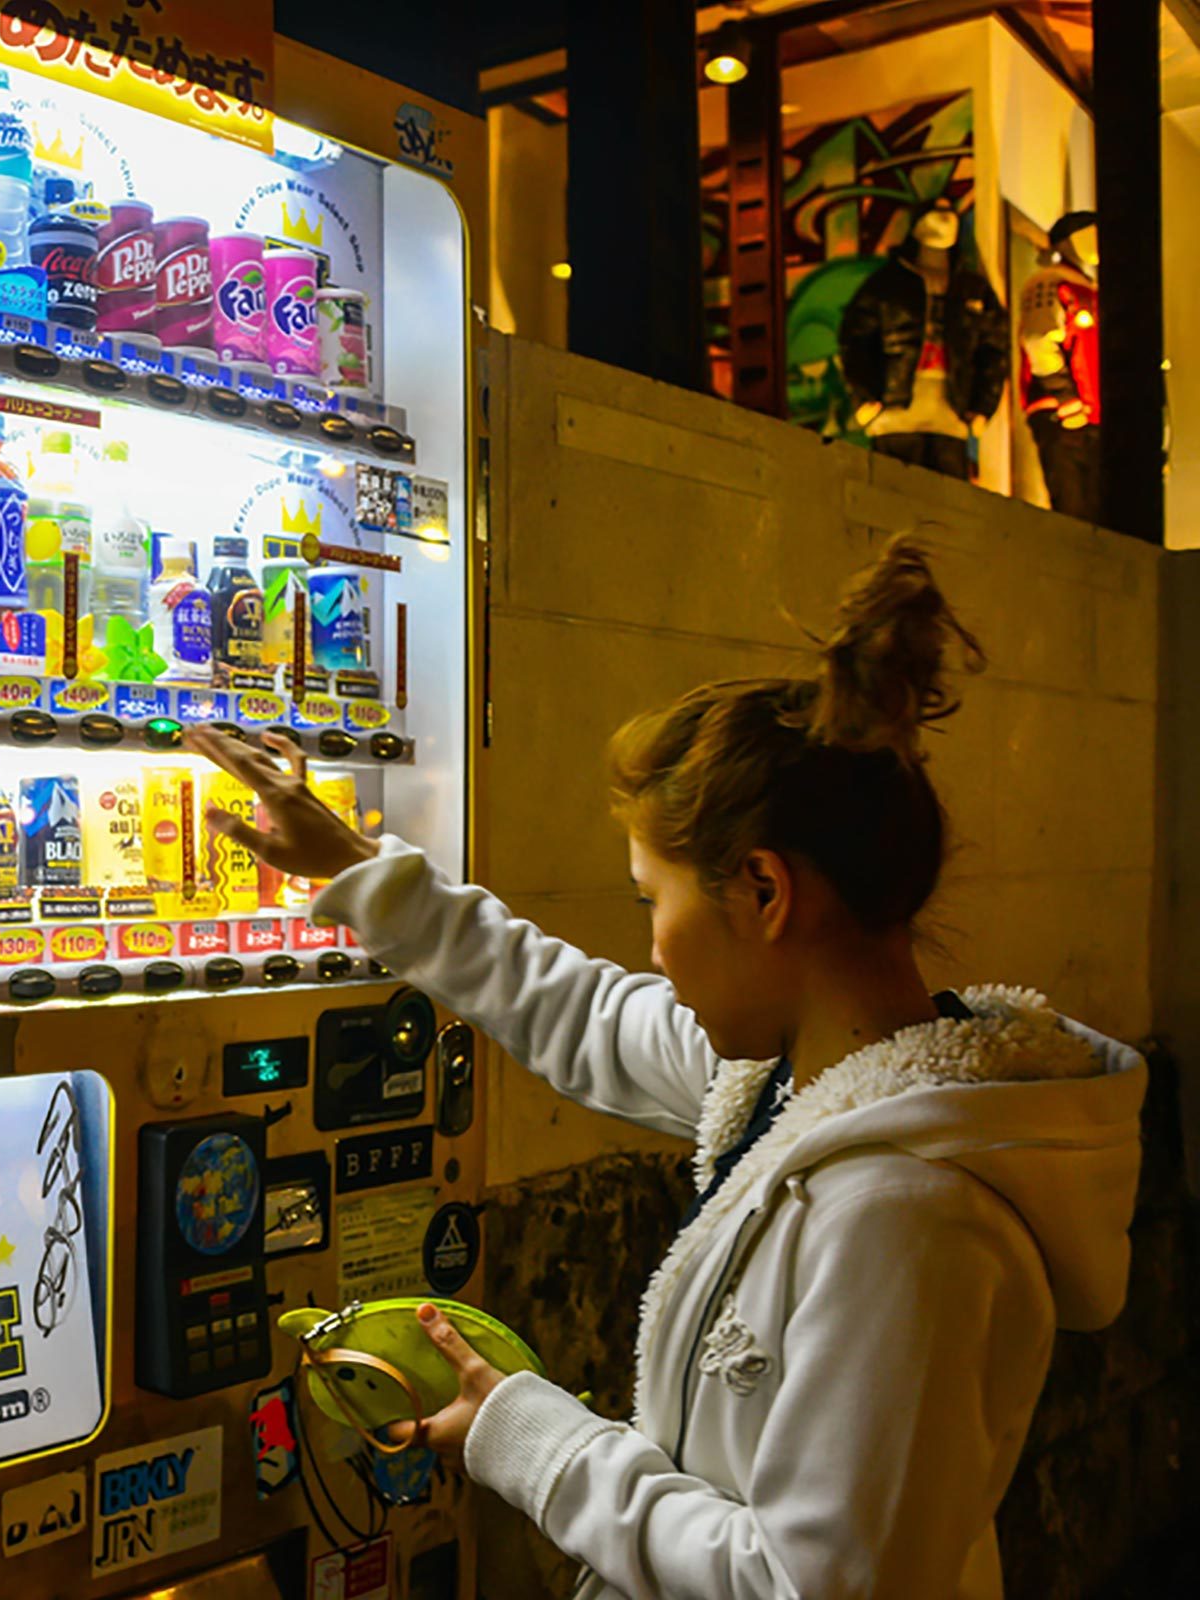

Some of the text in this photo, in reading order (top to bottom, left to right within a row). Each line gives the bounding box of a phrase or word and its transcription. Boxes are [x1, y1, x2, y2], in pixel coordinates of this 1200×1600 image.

[111, 248, 156, 285] Pepp
[217, 280, 265, 323] Fan
[60, 935, 97, 952] 110円
[132, 931, 166, 948] 110円
[100, 1447, 195, 1516] BRKLY
[95, 1508, 158, 1567] JPN
